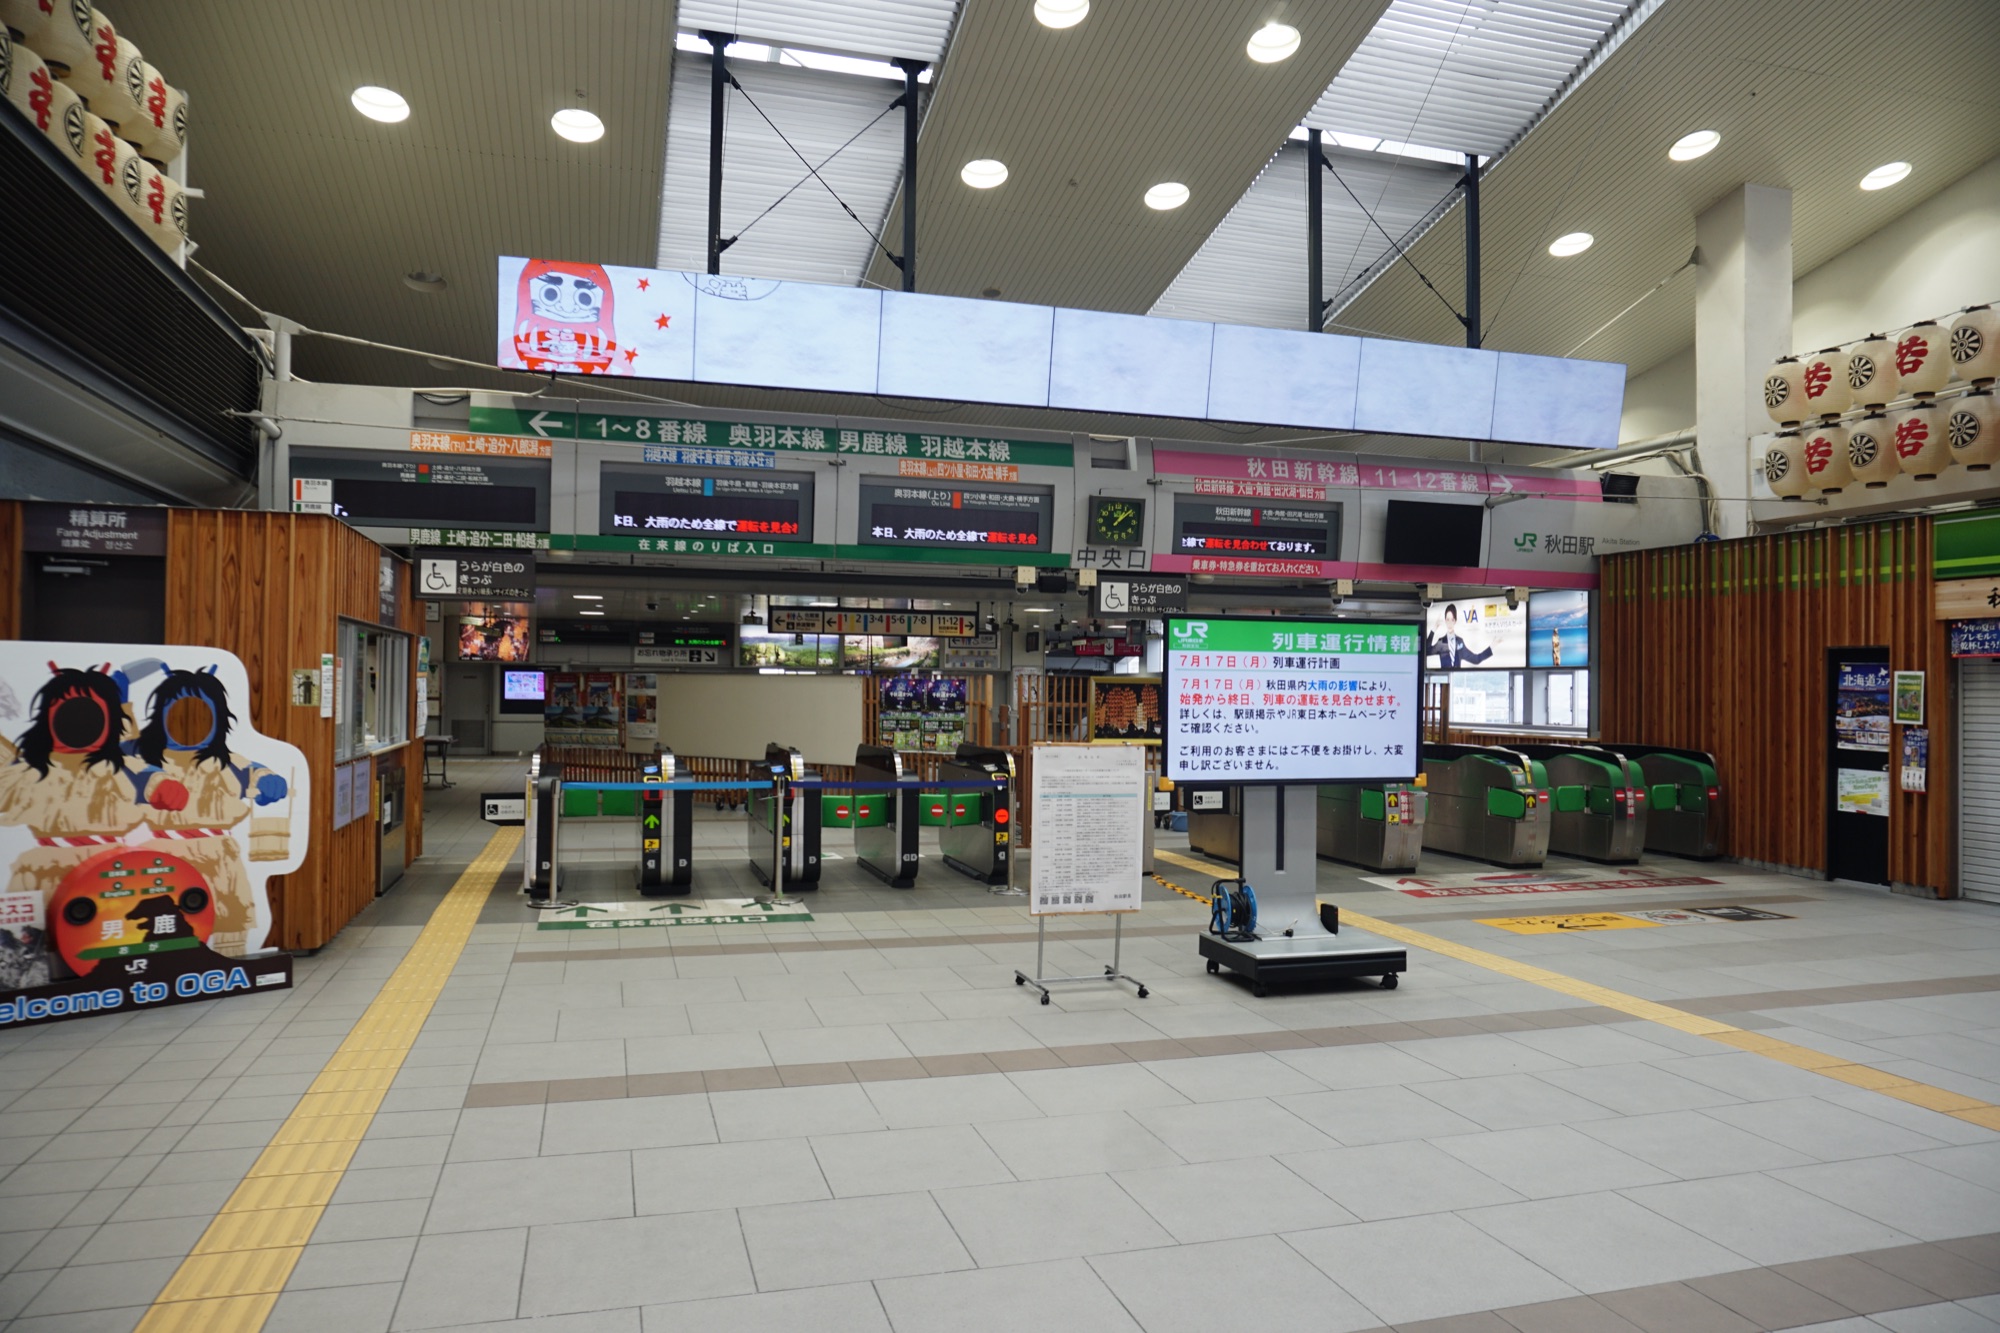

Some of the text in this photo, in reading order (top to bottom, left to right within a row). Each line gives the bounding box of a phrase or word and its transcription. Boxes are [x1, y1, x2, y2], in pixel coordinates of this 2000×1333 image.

[729, 424, 825, 450] 奥羽本線
[838, 430, 908, 455] 男鹿線
[920, 435, 1011, 461] 羽越本線
[1247, 457, 1360, 484] 秋田新幹線
[665, 476, 702, 488] 羽越本線
[1195, 478, 1235, 494] 秋田新幹線
[69, 508, 128, 529] 精算所
[1215, 506, 1252, 517] 秋田新幹線
[56, 527, 139, 540] Fare Adjustment
[410, 529, 442, 545] 男鹿線
[871, 526, 1038, 545] 本日、大雨のため全線で運転を見合
[1514, 533, 1538, 548] JR
[638, 538, 775, 555] 在来線のりば入口
[1544, 534, 1595, 556] 秋田駅
[1601, 537, 1641, 546] Akita Station
[1077, 547, 1146, 570] 中央口
[459, 560, 525, 574] うらが白色の
[1192, 559, 1321, 575] 乗車券・特急券を重ねてお入れください。
[459, 574, 493, 586] きっぷ
[1131, 582, 1182, 595] うらが白色の
[1131, 594, 1157, 605] きっぷ
[843, 614, 848, 623] 1
[855, 614, 862, 623] 2
[1173, 621, 1209, 639] JR
[1271, 631, 1411, 653] 列車運行情報
[1842, 673, 1891, 687] 北海道フェア
[1179, 693, 1401, 707] 始発から終日、列車の運転を見合わせます。
[1179, 722, 1260, 735] ご確認ください。
[1179, 744, 1404, 758] ご利用のお客さまにはご不便をお掛けし、大変
[1179, 759, 1280, 772] 申し訳ございません。
[103, 890, 132, 898] English
[0, 903, 34, 916] スコ
[100, 913, 177, 941] 男鹿
[586, 914, 768, 928] 在来線改札口
[124, 958, 148, 972] JR
[129, 981, 169, 1005] to
[175, 966, 251, 999] OGA
